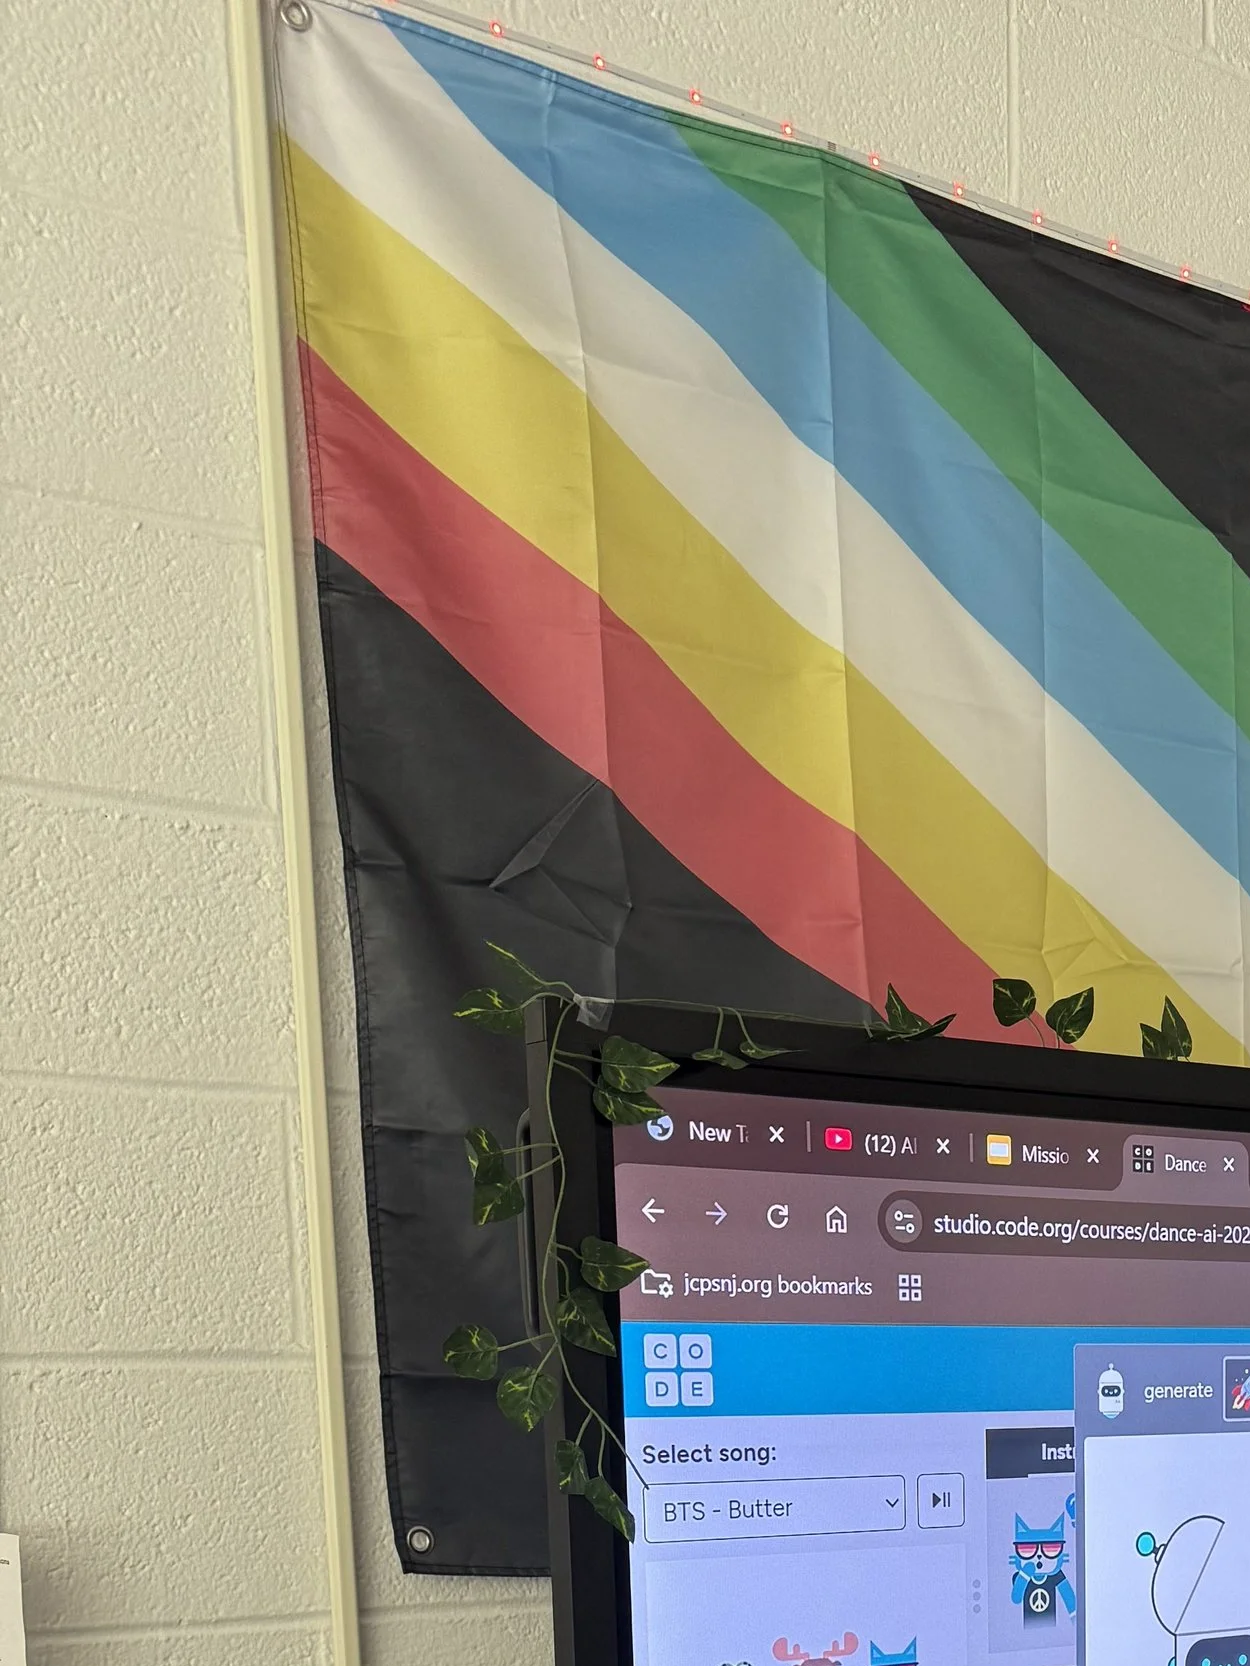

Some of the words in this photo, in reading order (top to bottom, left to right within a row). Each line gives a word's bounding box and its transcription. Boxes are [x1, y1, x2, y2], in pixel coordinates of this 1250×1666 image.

[689, 1120, 732, 1143] New
[865, 1134, 896, 1157] (12)
[1022, 1145, 1070, 1165] Missio
[1164, 1153, 1207, 1174] Dance
[683, 1271, 773, 1299] jcpsnj.org
[778, 1273, 873, 1297] bookmarks
[1144, 1381, 1213, 1404] generate
[642, 1443, 713, 1465] Select
[718, 1444, 777, 1467] song:
[663, 1501, 706, 1522] BTS
[728, 1498, 793, 1519] Butter
